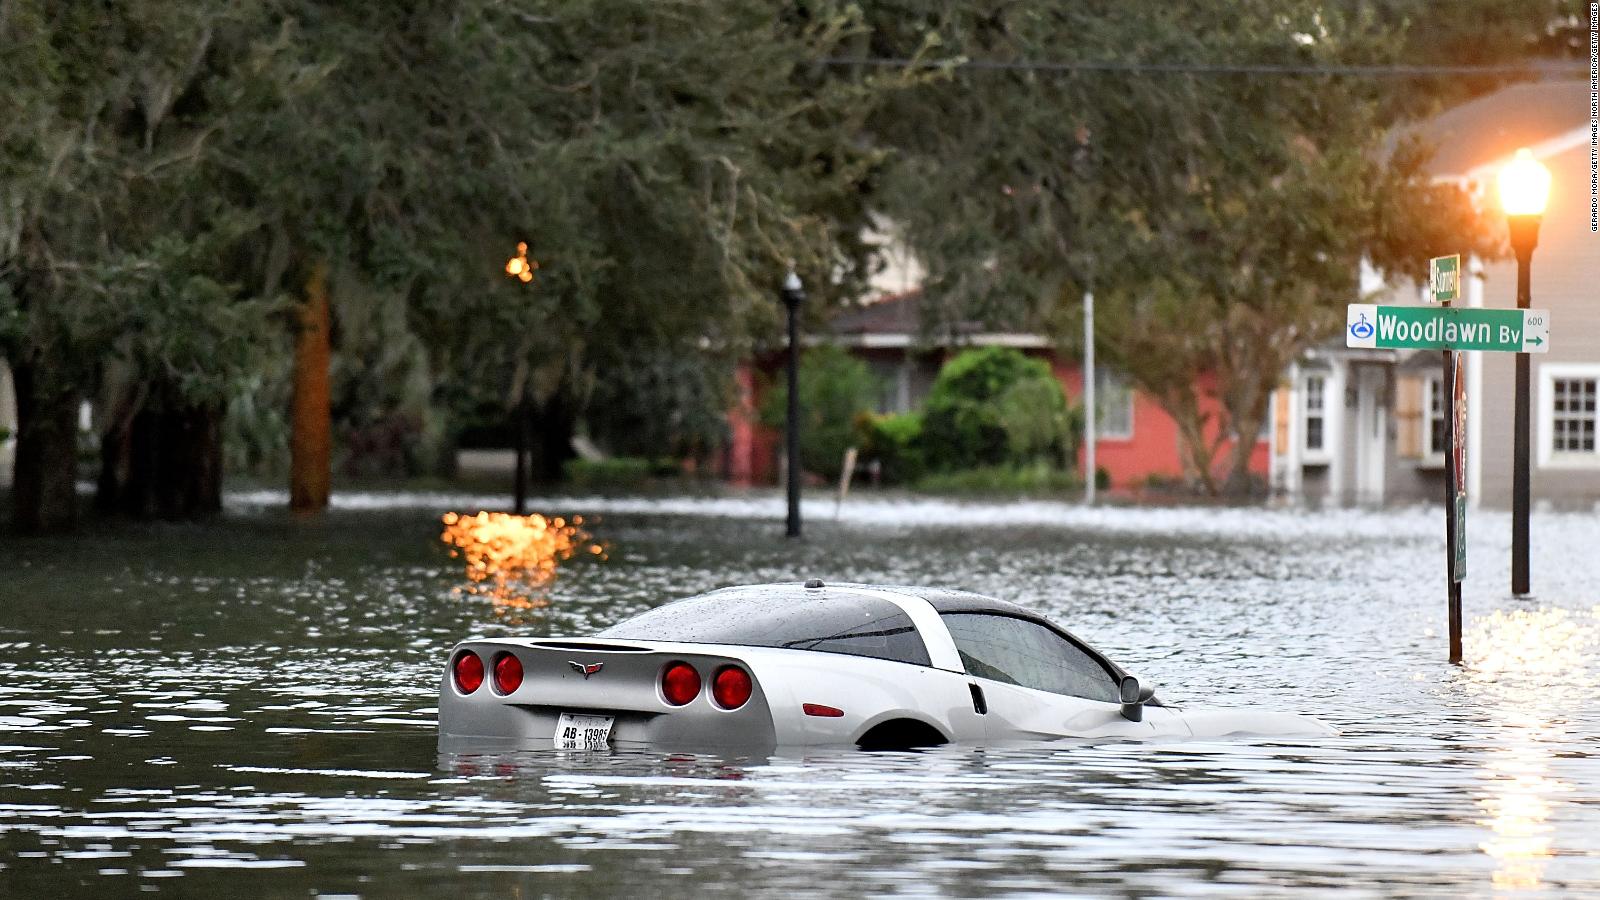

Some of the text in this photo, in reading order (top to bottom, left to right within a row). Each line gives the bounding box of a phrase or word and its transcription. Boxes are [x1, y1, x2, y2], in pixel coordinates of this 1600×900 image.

[1378, 314, 1520, 344] Woodlawn Bv
[1527, 317, 1542, 326] 600
